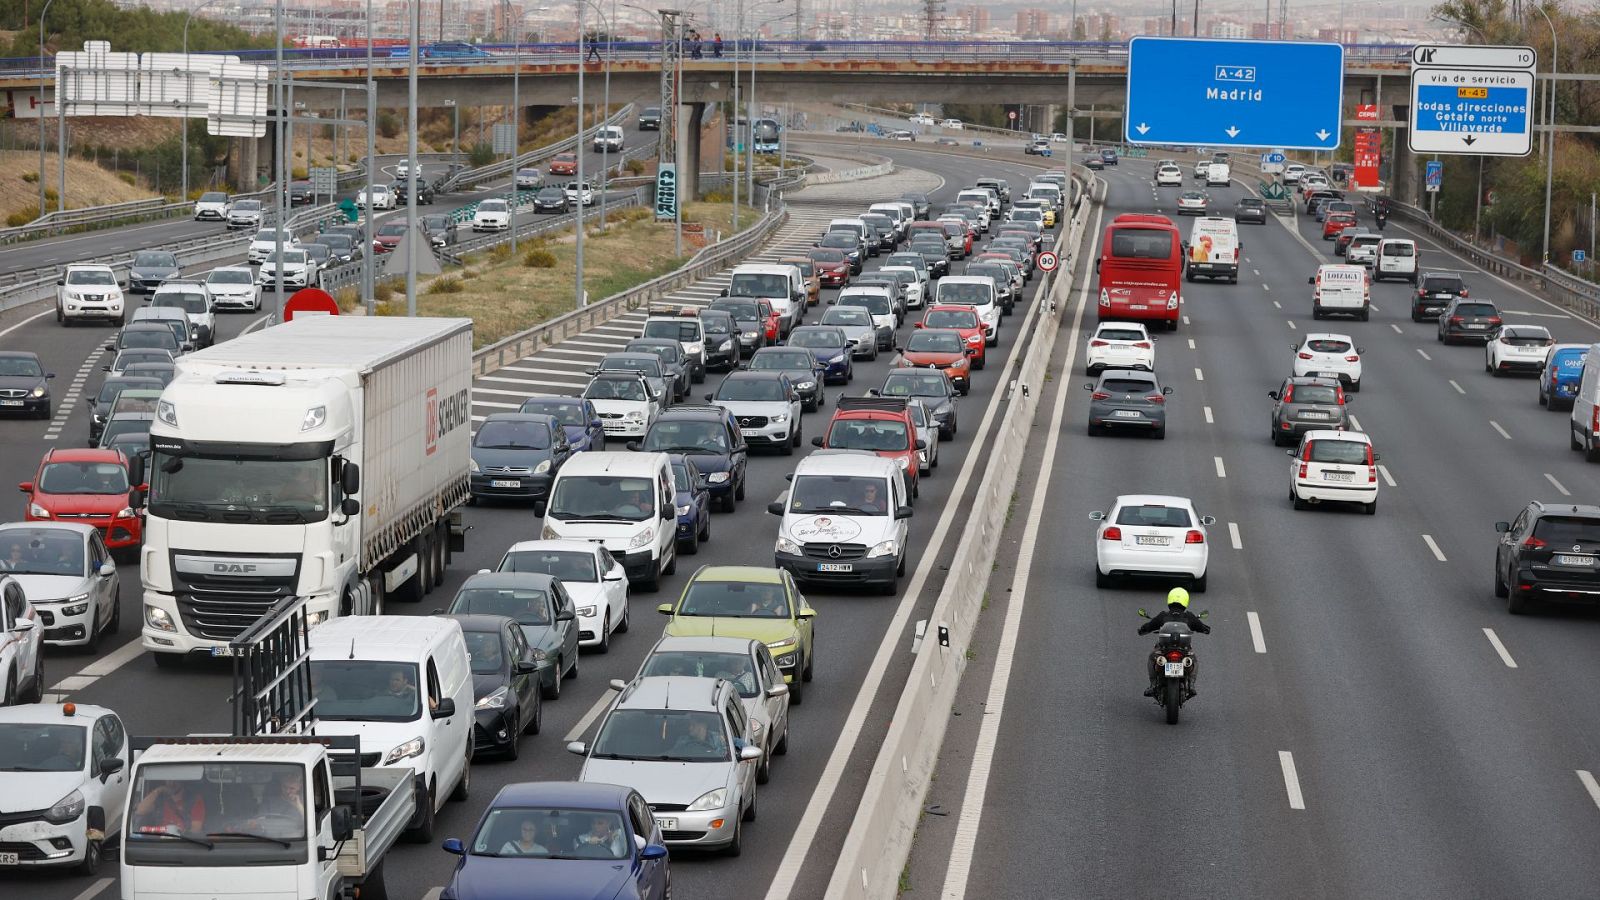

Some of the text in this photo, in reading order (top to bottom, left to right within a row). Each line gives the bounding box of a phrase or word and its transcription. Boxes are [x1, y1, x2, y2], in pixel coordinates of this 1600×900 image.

[1518, 54, 1530, 63] 10
[1218, 68, 1253, 80] A-42
[1453, 74, 1465, 83] de
[1472, 75, 1516, 84] servicio
[1206, 87, 1262, 101] Madrid
[1459, 89, 1486, 97] M-45
[1418, 102, 1526, 113] todas direcciones
[1435, 112, 1507, 123] Getafe norte
[1440, 122, 1503, 133] Villaverde
[1041, 257, 1054, 265] 90
[427, 388, 468, 445] DB SCHENKER
[213, 563, 257, 573] DAF
